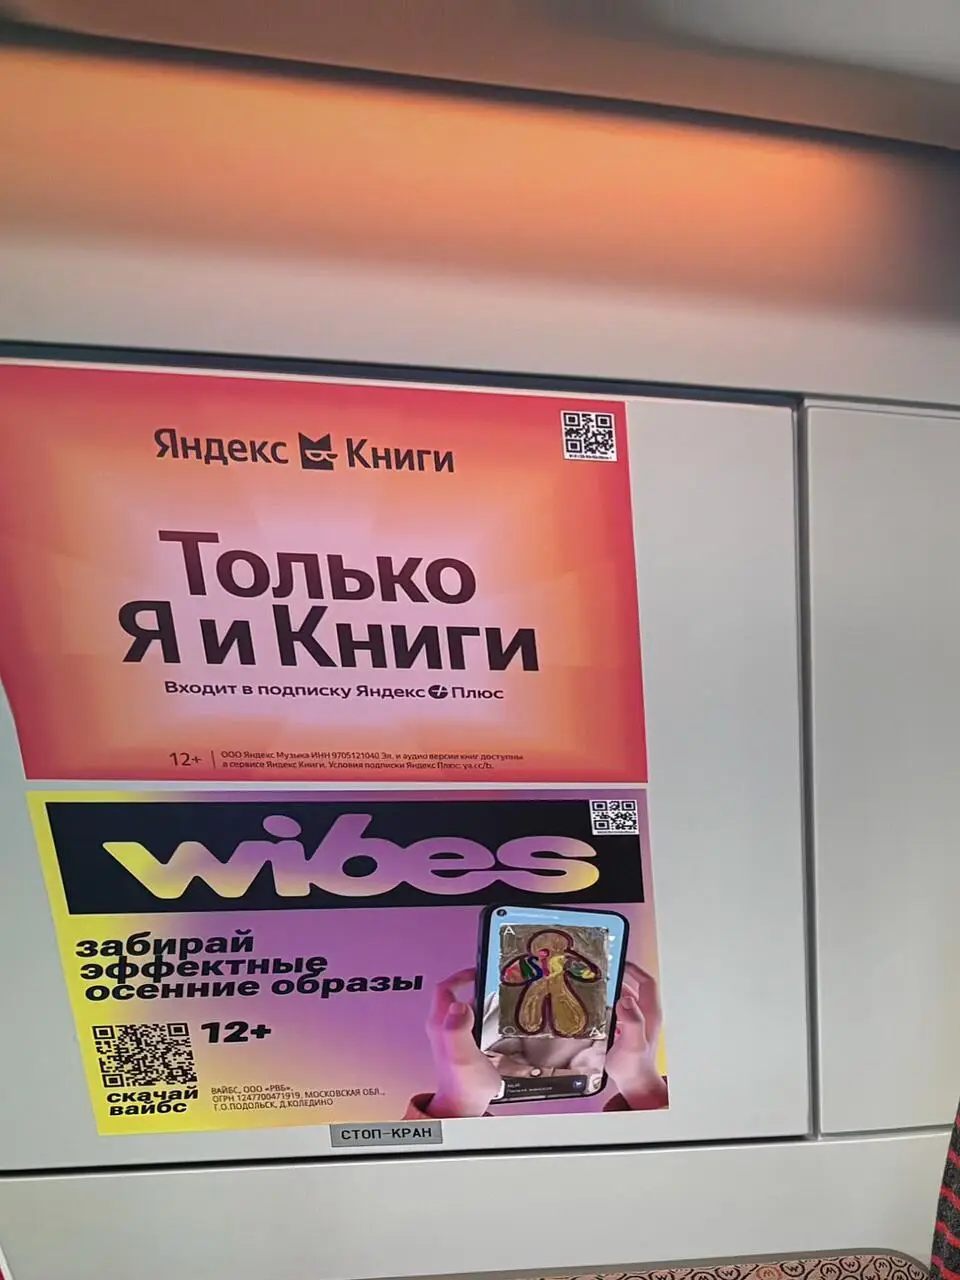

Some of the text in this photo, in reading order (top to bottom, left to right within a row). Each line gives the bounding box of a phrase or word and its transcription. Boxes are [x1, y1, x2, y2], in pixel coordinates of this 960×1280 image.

[153, 428, 455, 473] Яндекс Книги
[158, 530, 477, 605] Только
[118, 600, 540, 671] Я и Книги
[164, 680, 505, 700] Входит в подписку Яндекс Плюс
[169, 752, 203, 767] 12+
[221, 751, 242, 759] ООО
[243, 751, 276, 760] Яндекс
[276, 751, 310, 760] Музыка
[310, 751, 331, 759] ИНН
[331, 751, 380, 760] 9705121040
[480, 754, 524, 762] доступны
[229, 761, 265, 769] сервисе
[266, 760, 297, 769] Яндекс
[329, 761, 364, 769] Условия
[364, 762, 405, 770] подписки
[406, 761, 436, 770] Яндекс
[102, 813, 600, 899] wibes
[75, 929, 254, 960] забирай
[80, 955, 329, 984] эффектные
[85, 972, 424, 1001] осенние образы
[200, 1021, 272, 1044] 12+
[106, 1085, 199, 1103] скачай
[212, 1094, 235, 1103] ОГРН
[304, 1088, 361, 1099] МОСКОВСКАЯ
[243, 1085, 263, 1094] ООО
[109, 1100, 188, 1116] вайбс
[279, 1098, 334, 1109] Д.КОЛЕДИНО
[341, 1127, 432, 1140] СТОП-КРАН
